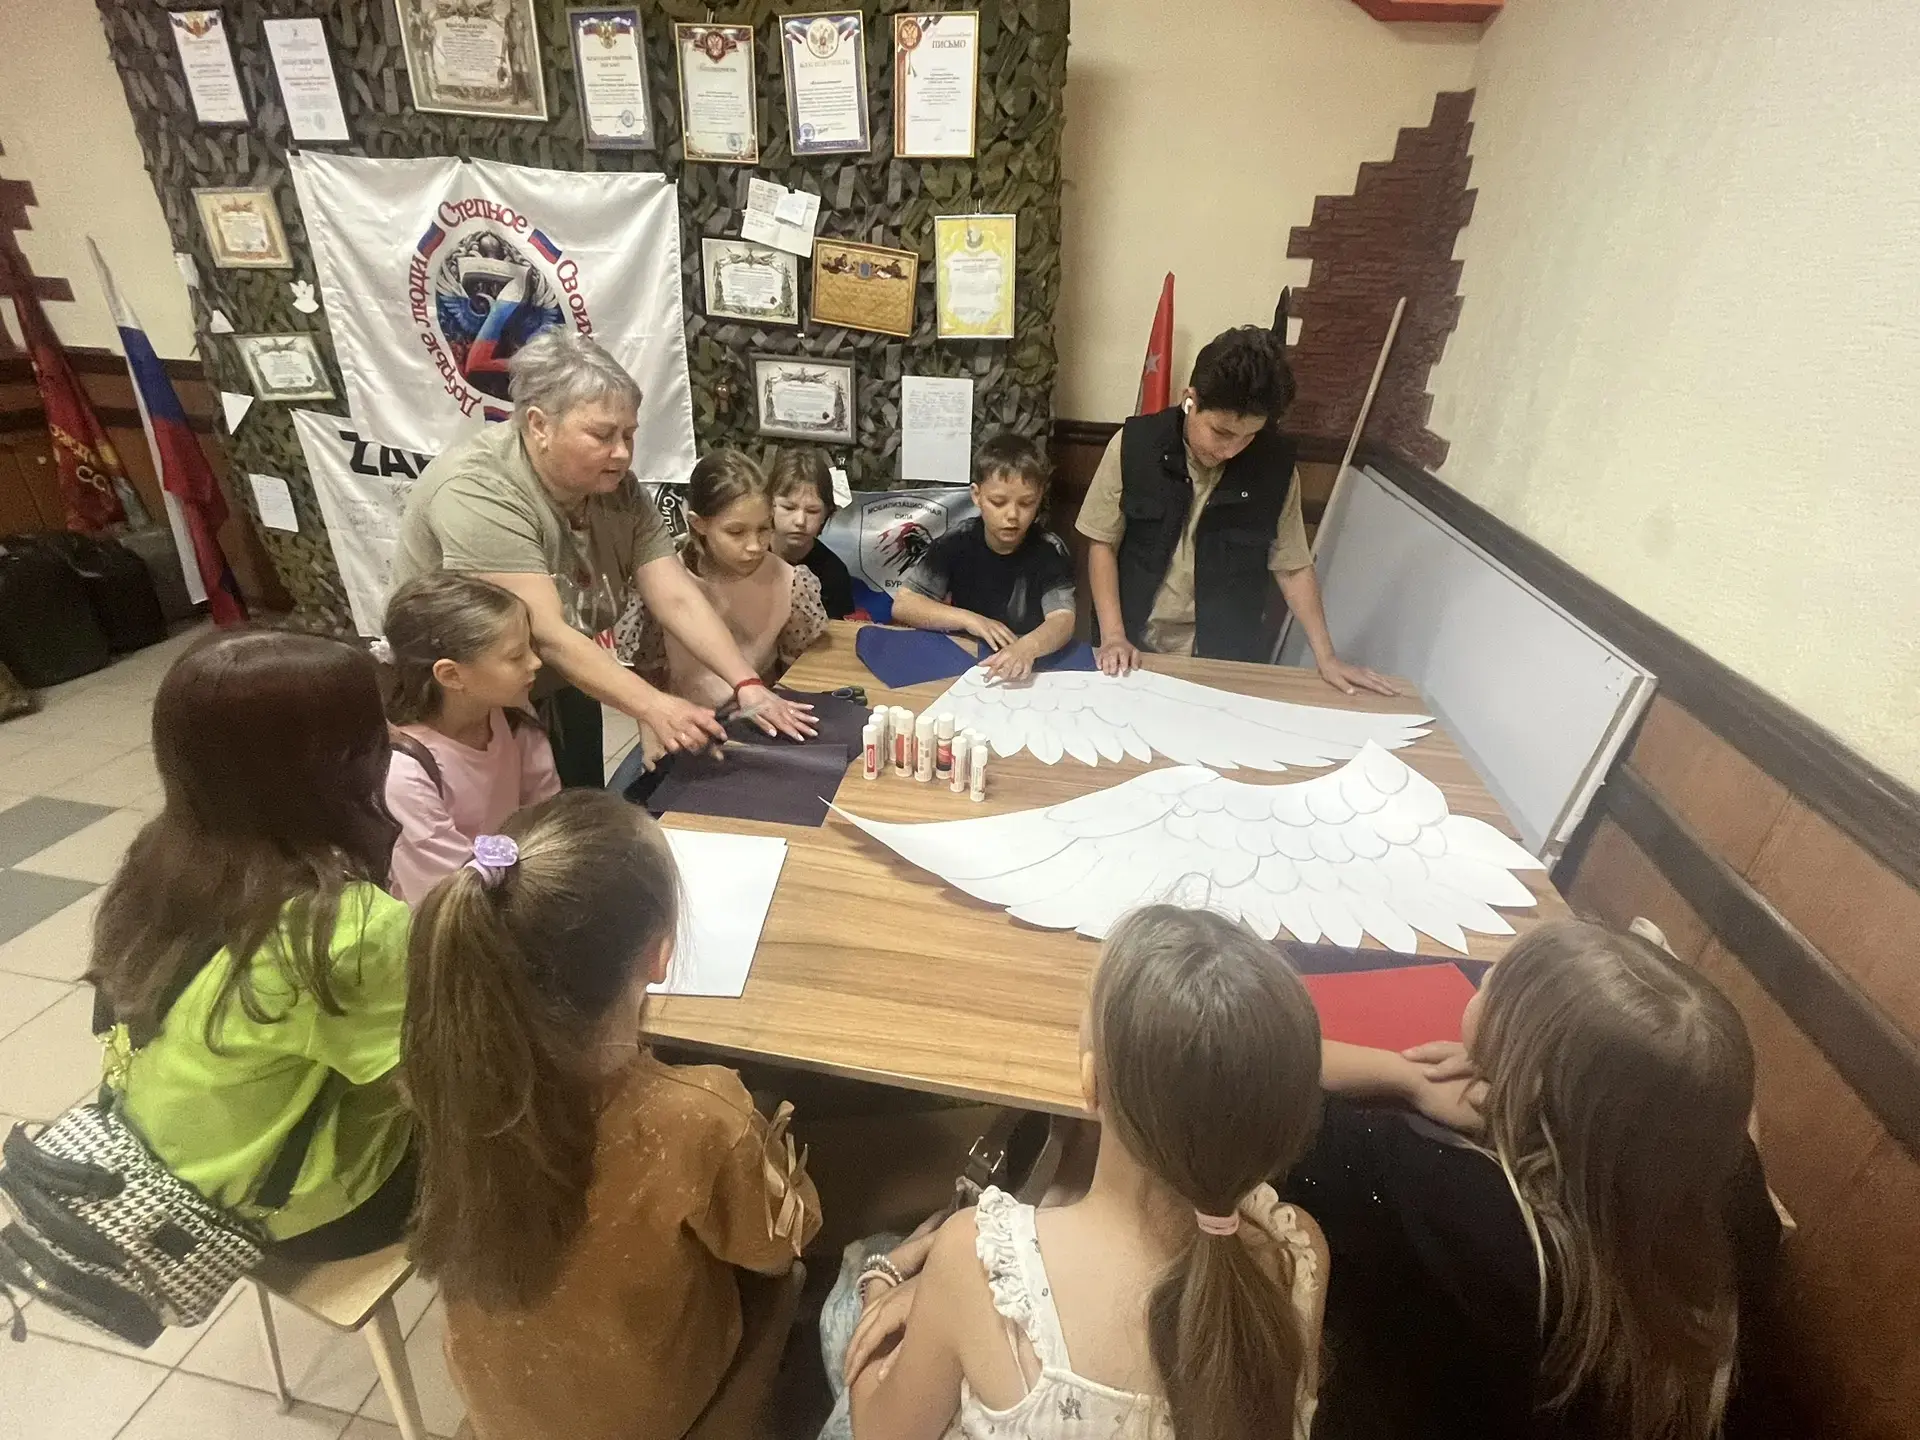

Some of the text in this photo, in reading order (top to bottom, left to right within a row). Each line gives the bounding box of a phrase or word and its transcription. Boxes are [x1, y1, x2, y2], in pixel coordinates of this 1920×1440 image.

[932, 40, 967, 49] ПИСЬМО
[438, 198, 528, 234] Степное
[409, 254, 483, 418] Добрые люди
[894, 508, 913, 520] СИЛА
[884, 579, 903, 589] БУР
